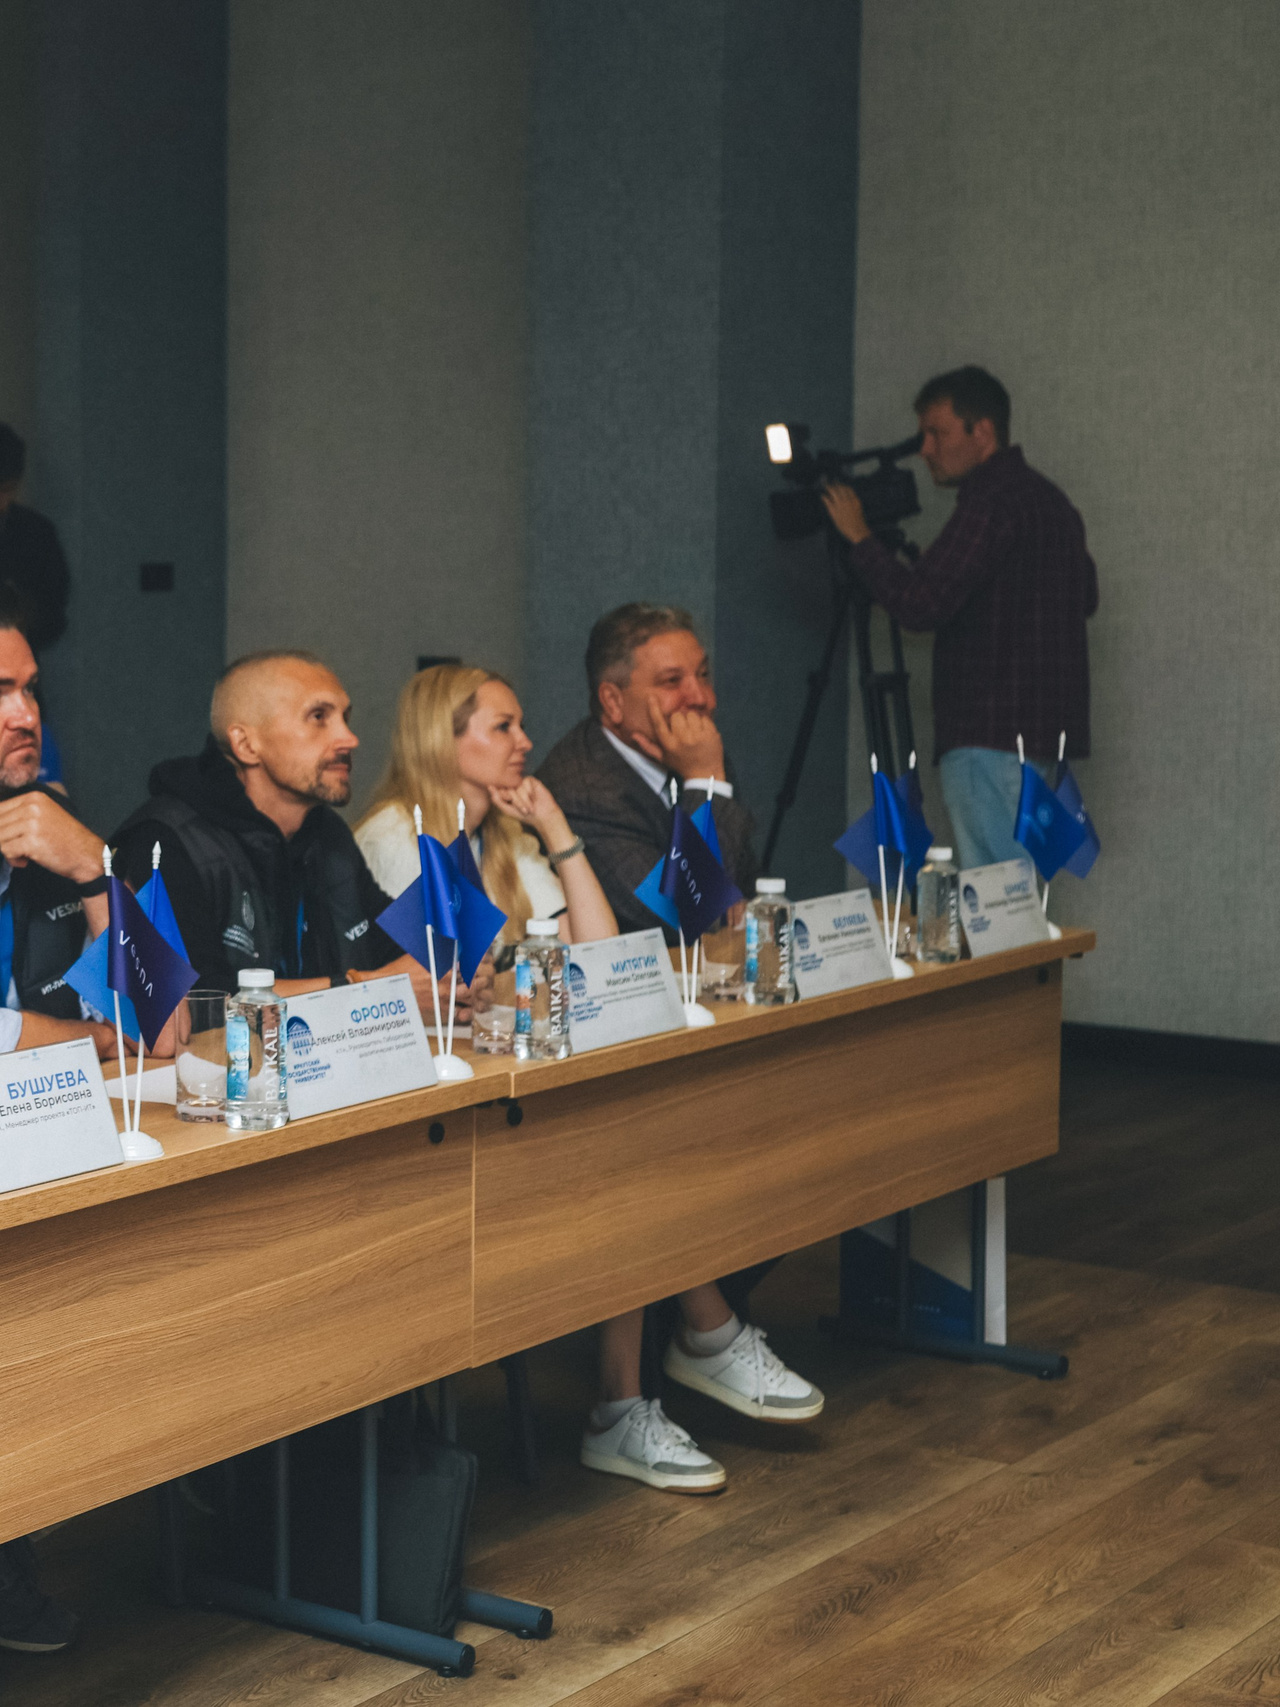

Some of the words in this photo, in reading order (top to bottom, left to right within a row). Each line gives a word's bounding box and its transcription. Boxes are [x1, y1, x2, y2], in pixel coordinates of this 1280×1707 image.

[344, 919, 370, 941] VES
[350, 999, 407, 1023] ФРОЛОВ
[550, 969, 563, 1036] BAIKAL
[310, 1030, 347, 1047] Алексей
[348, 1018, 410, 1039] Владимирович
[265, 1026, 278, 1101] BAIKAL
[7, 1069, 89, 1100] БУШУЕВА
[0, 1101, 33, 1117] Елена
[34, 1088, 93, 1110] Борисовна
[5, 1115, 40, 1131] Менеджер
[40, 1111, 65, 1125] проекта
